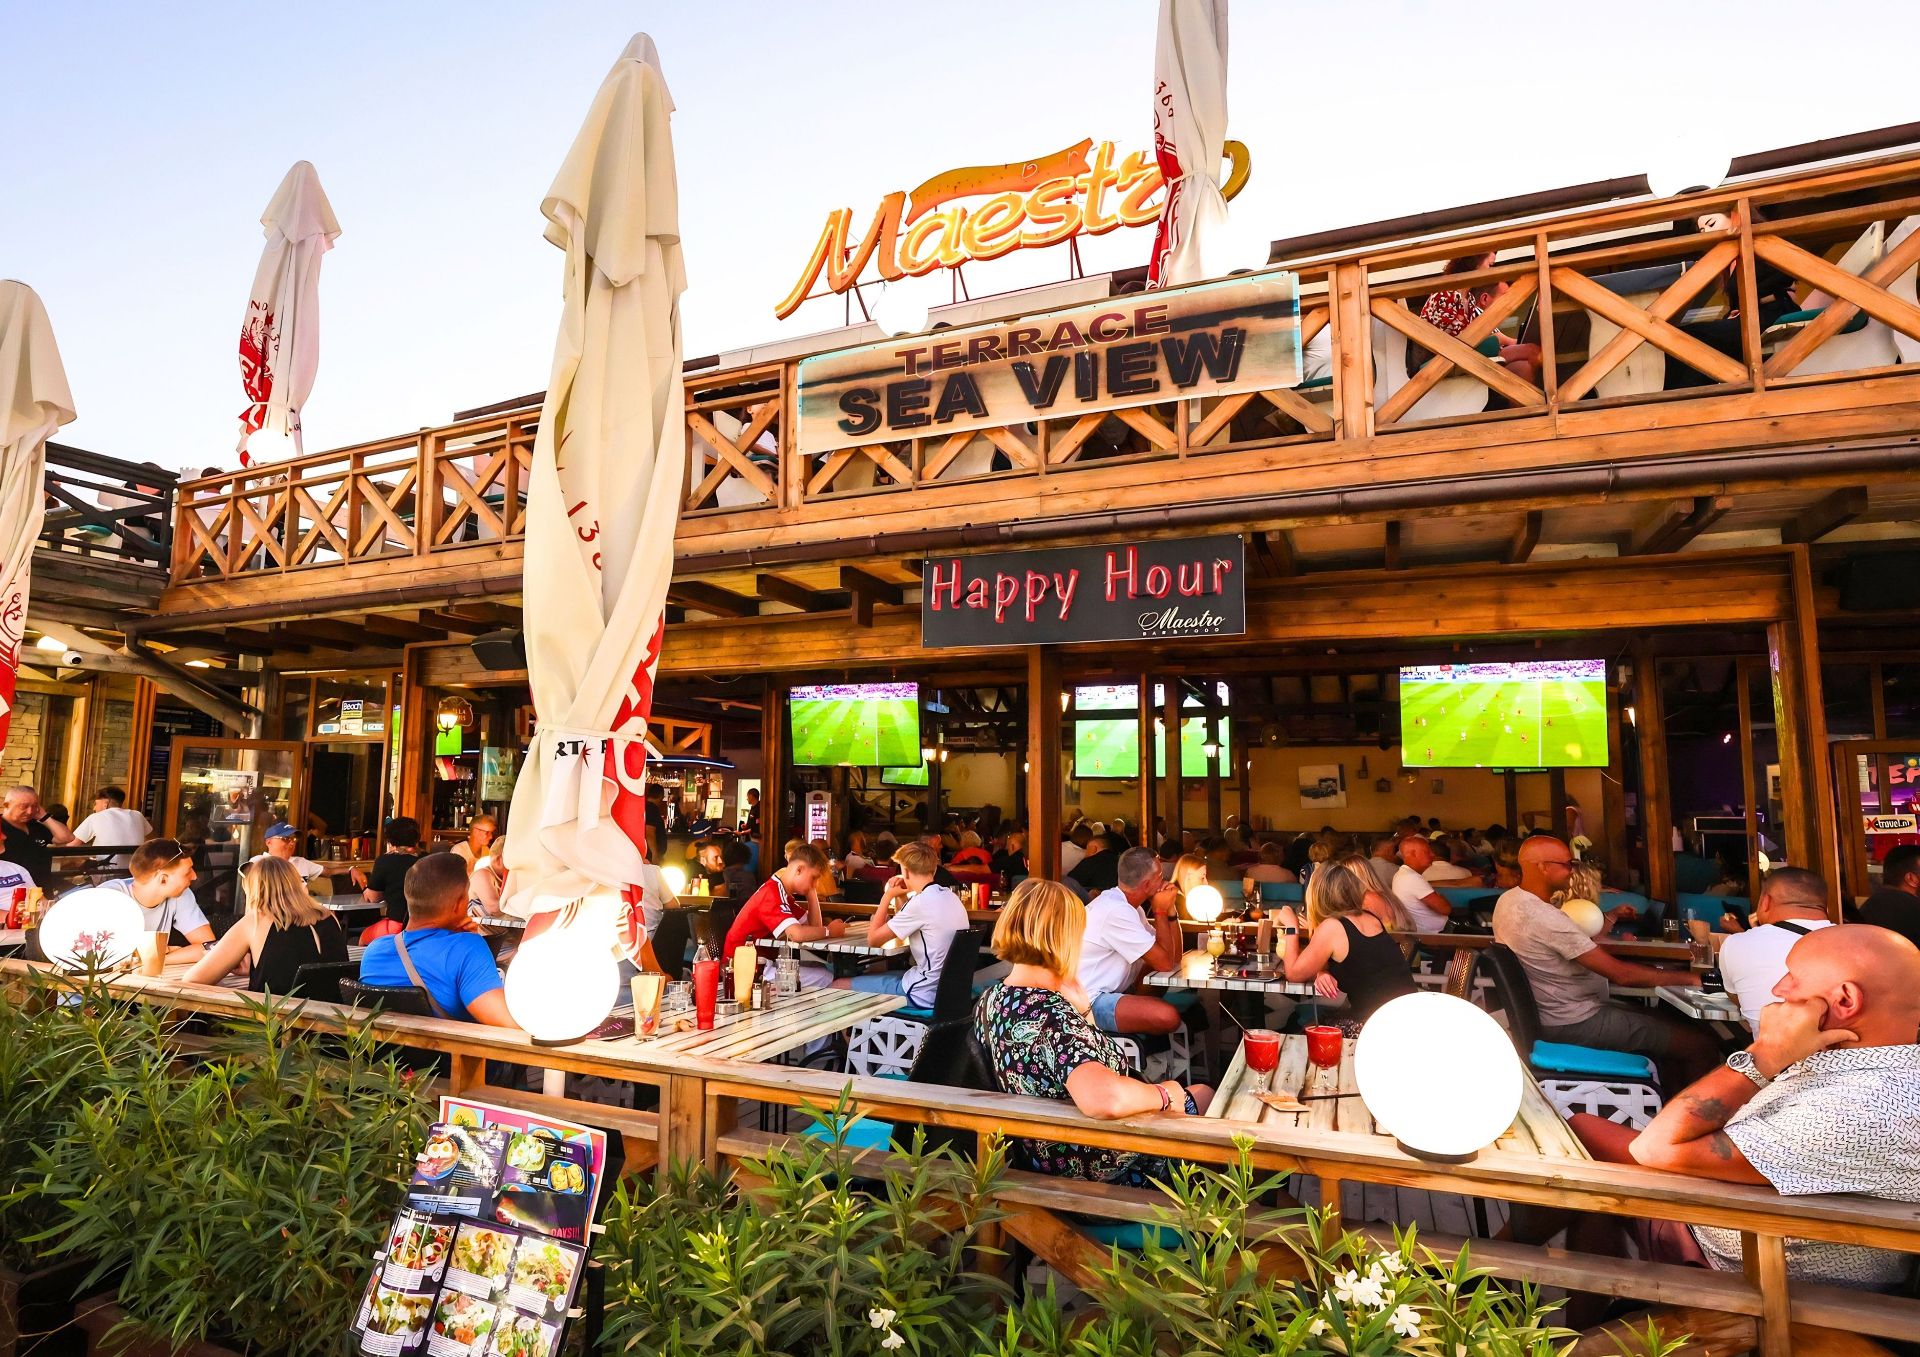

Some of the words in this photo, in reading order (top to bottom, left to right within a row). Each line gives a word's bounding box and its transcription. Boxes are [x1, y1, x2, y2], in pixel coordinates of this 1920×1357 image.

[895, 304, 1173, 377] TERRACE
[838, 373, 990, 436] SEA
[1011, 327, 1247, 409] VIEW
[931, 559, 1079, 624] Happy
[1105, 545, 1233, 602] Hour
[1138, 606, 1226, 631] Maestro
